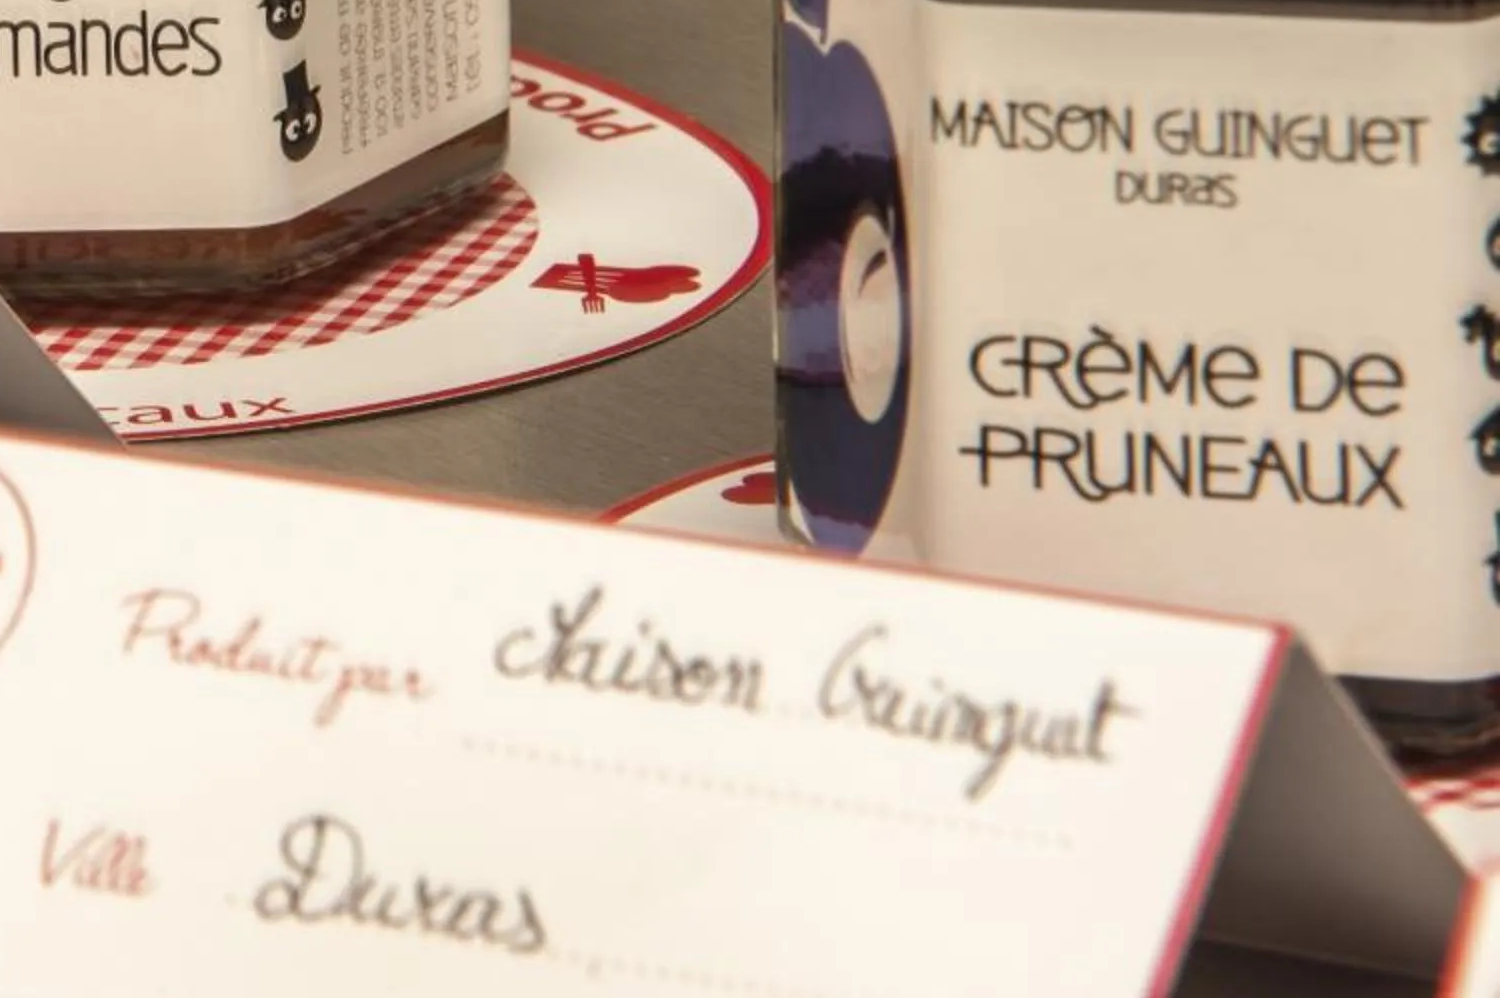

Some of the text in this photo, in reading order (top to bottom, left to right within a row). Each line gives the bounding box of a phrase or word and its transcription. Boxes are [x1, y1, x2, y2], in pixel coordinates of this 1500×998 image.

[930, 96, 1133, 153] MAISON
[958, 423, 1404, 510] PRUNEAUX
[120, 588, 436, 729] Produit par
[40, 817, 153, 897] Ville
